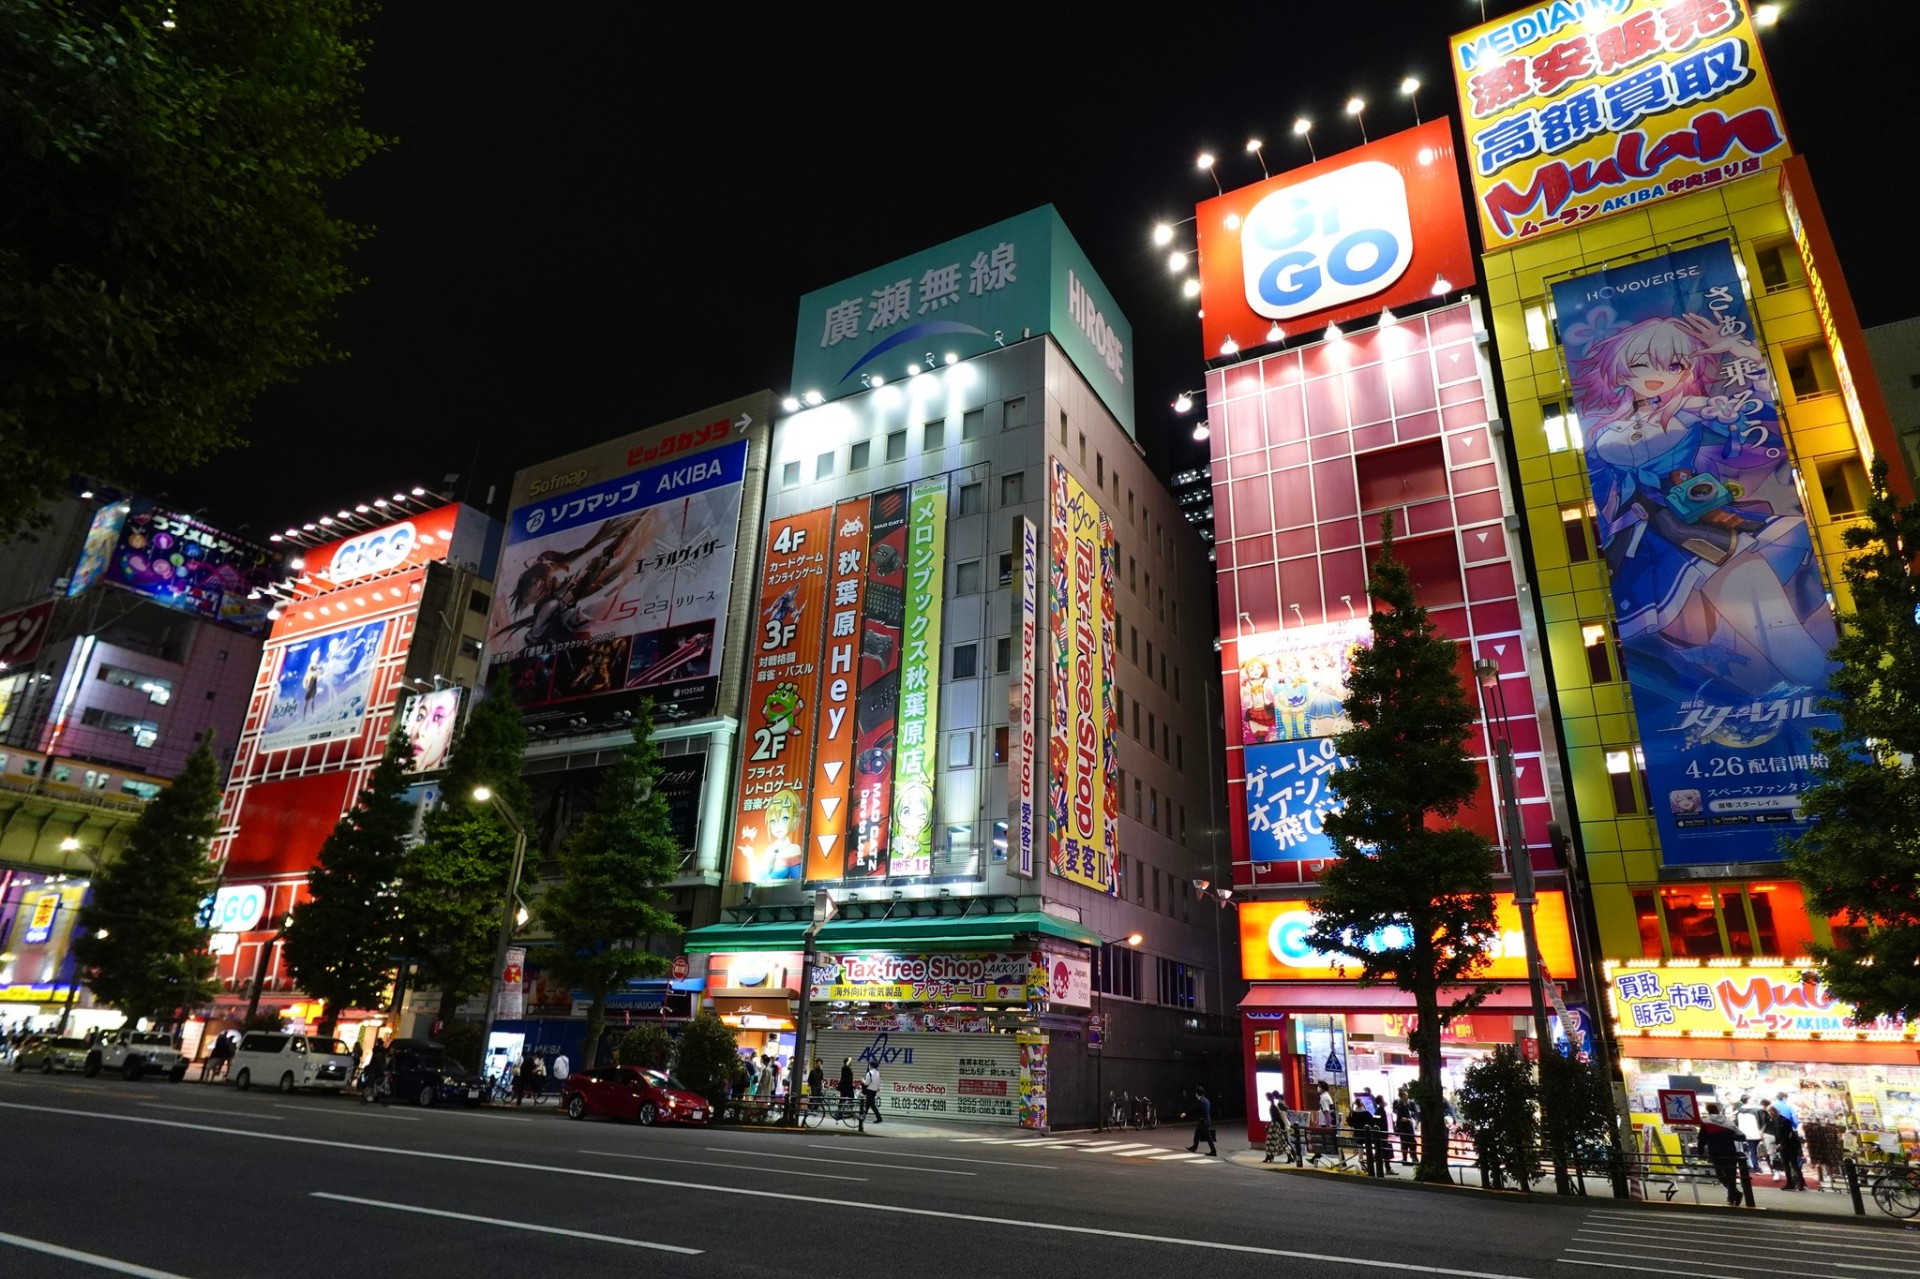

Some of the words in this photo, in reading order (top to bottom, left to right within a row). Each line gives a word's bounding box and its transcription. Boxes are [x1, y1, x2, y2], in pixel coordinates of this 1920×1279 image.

[1471, 0, 1730, 114] 激安販売
[1477, 41, 1742, 174] 高額買取
[1518, 203, 1600, 237] ムーラン
[1602, 185, 1665, 212] AKIBA
[1666, 157, 1762, 193] 中央通り店
[1258, 228, 1399, 307] GO
[820, 242, 1018, 349] 廣瀬無線
[1586, 265, 1701, 302] HOYOVERSE
[1068, 268, 1124, 385] HIROSE
[626, 417, 731, 468] ビックカメラ
[529, 468, 588, 497] Sofmap
[551, 481, 641, 523] ソフマップ
[656, 459, 722, 493] AKIBA
[773, 526, 806, 554] 4F
[769, 552, 824, 573] カードゲーム
[1024, 523, 1034, 597] AKKY
[768, 565, 823, 586] オンラインゲーム
[676, 591, 715, 608] リリース
[832, 548, 861, 638] 秋葉原
[762, 620, 796, 650] 3F
[900, 501, 935, 776] メロンブックス秋葉原店
[758, 652, 796, 667] 対戦格闘
[1022, 620, 1034, 726] Tax-free
[680, 686, 705, 696] YOSTAR
[1657, 696, 1828, 737] スターレイル
[750, 729, 786, 761] 2F
[747, 764, 786, 780] プライズ
[1021, 729, 1033, 798] Shop
[1686, 756, 1744, 780] 4.26
[1747, 753, 1829, 775] 配信開始
[746, 778, 803, 795] レトロゲーム
[743, 795, 791, 812] 音楽ゲーム
[892, 859, 911, 871] 地下
[914, 858, 929, 872] 1F
[844, 957, 925, 980] Tax-free
[929, 956, 985, 981] Shop
[833, 985, 902, 998] 海外向け電気製品
[1618, 972, 1662, 999] 買取
[1668, 985, 1713, 1009] 市場
[1633, 1001, 1673, 1026] 販売
[1736, 1014, 1793, 1030] ムーラン
[1796, 1018, 1840, 1030] AKIBA
